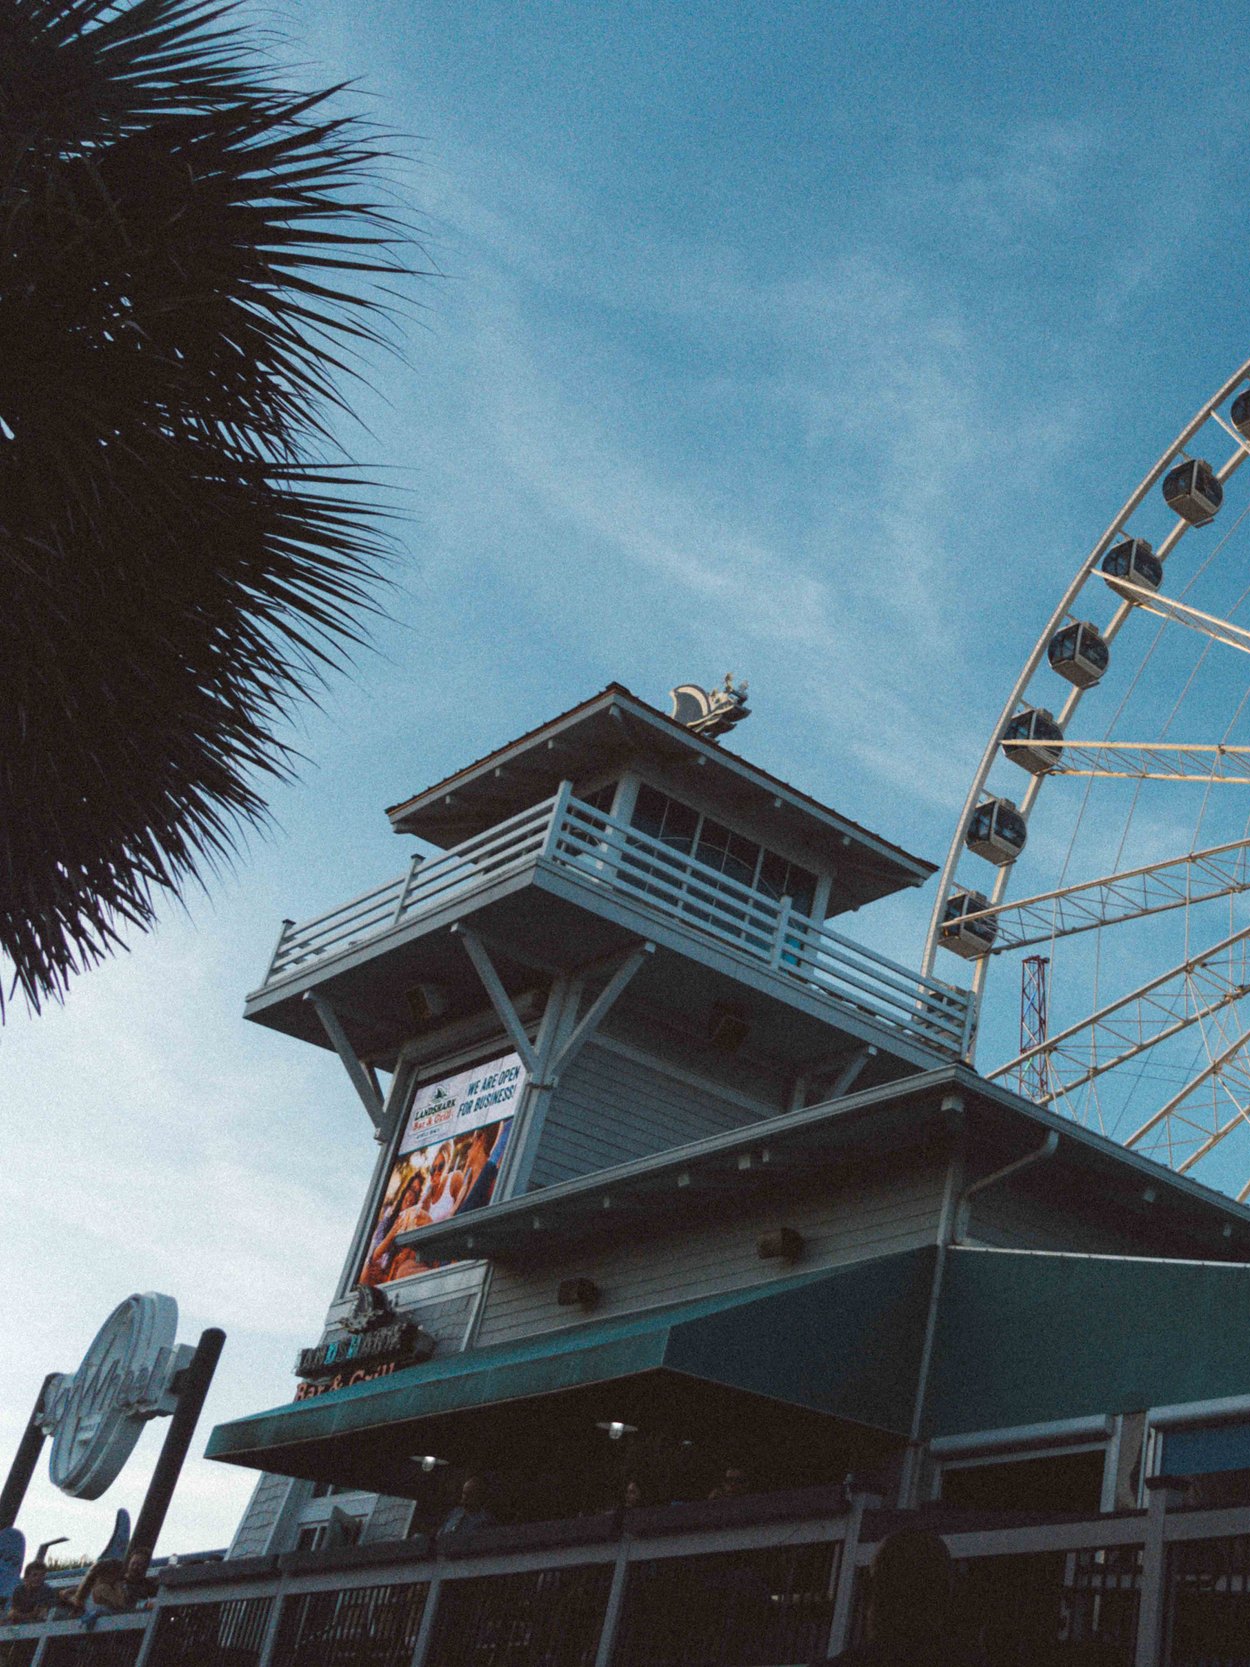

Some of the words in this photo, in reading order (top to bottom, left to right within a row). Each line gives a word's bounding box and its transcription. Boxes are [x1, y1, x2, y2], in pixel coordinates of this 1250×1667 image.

[468, 1080, 481, 1096] WE
[482, 1073, 499, 1090] ARE
[499, 1065, 521, 1085] OPEN
[415, 1099, 456, 1120] LANDSHARK
[457, 1100, 474, 1117] FOR
[473, 1083, 517, 1112] BUSINESS!
